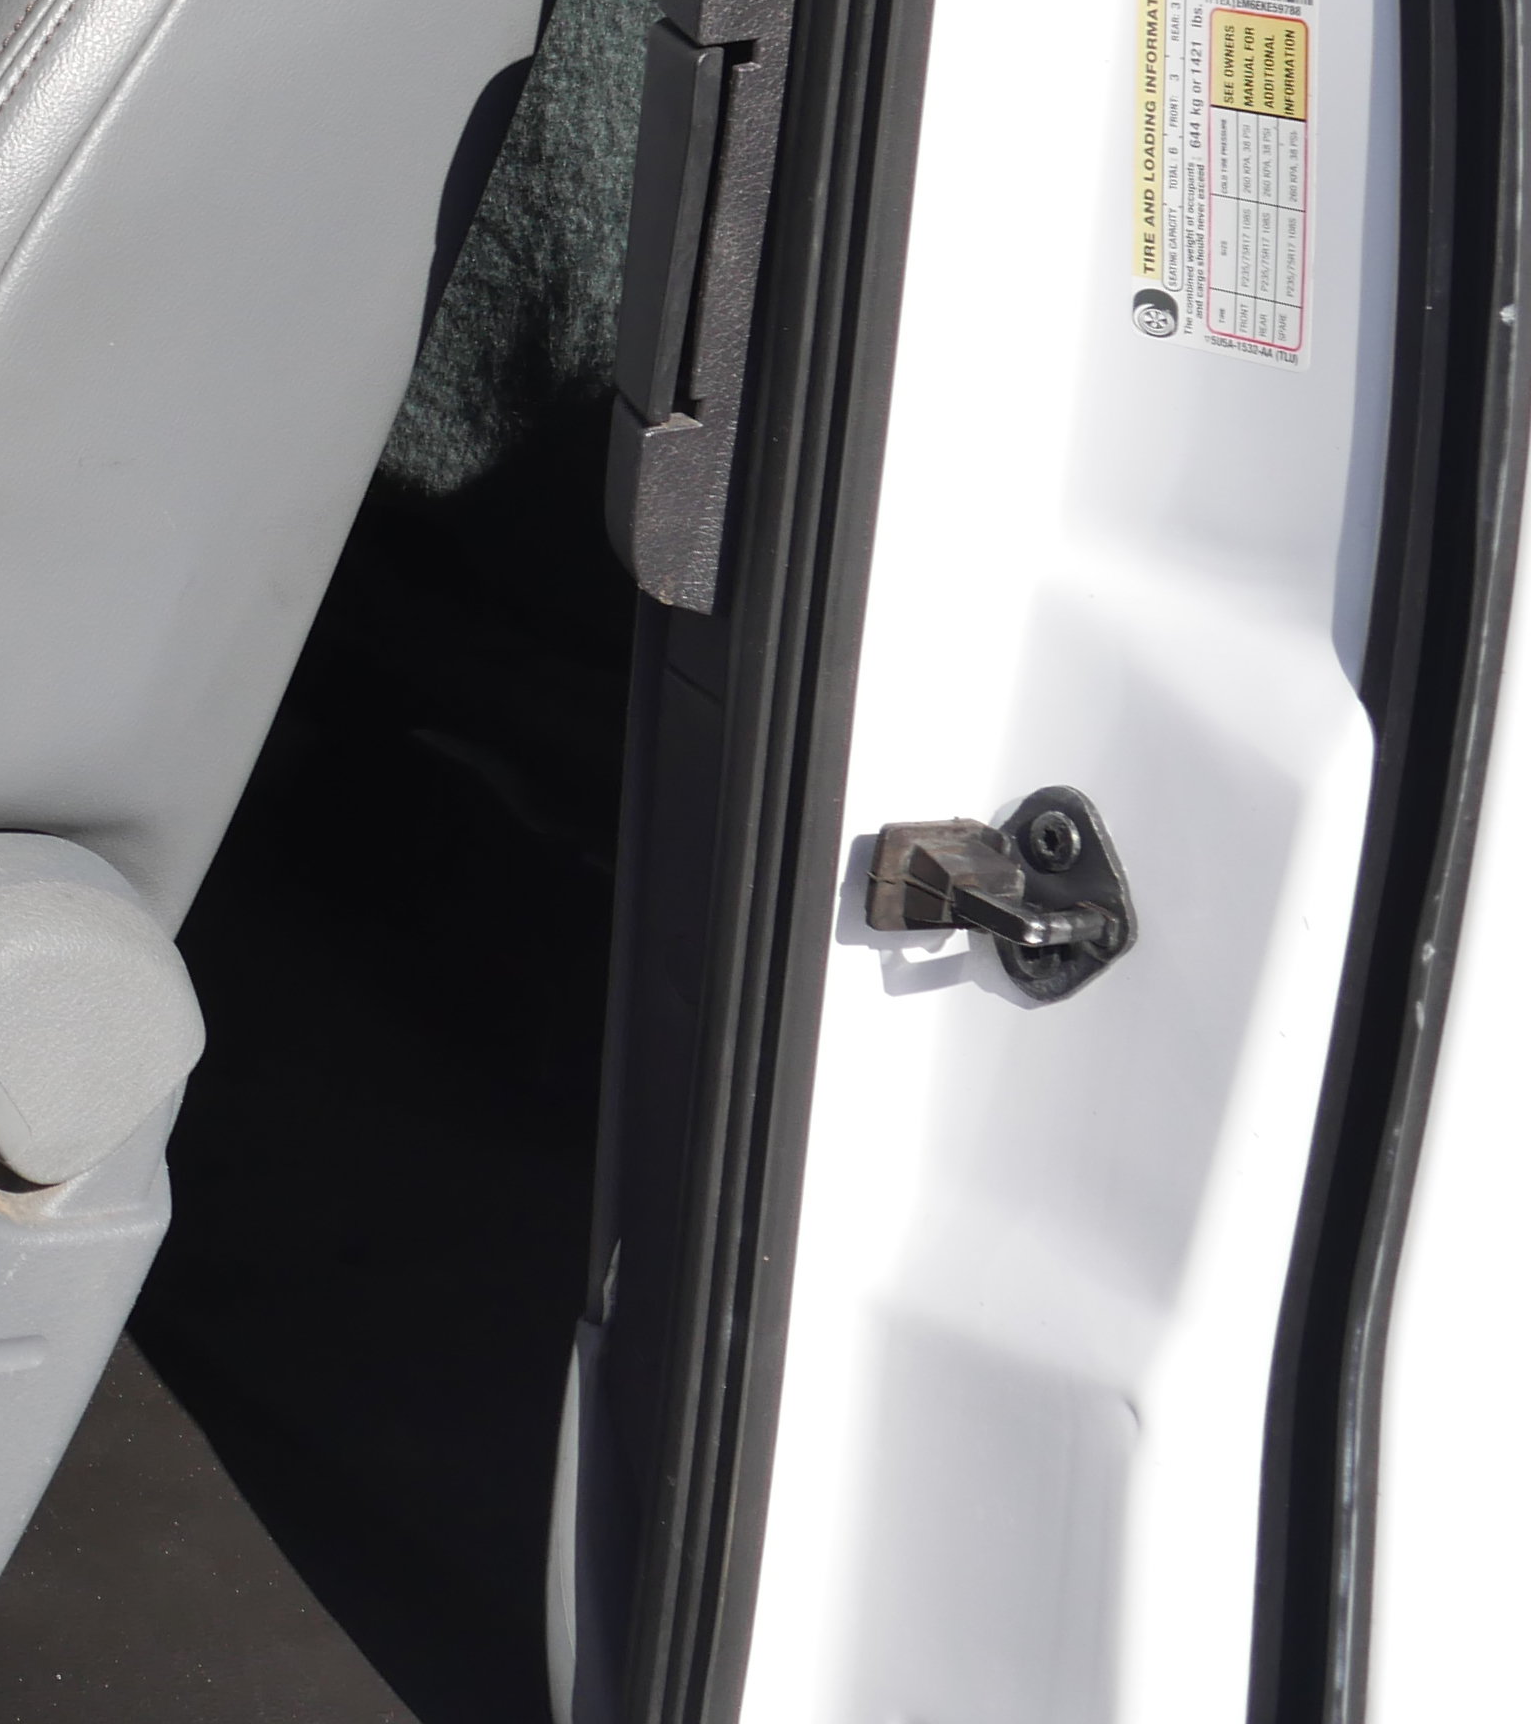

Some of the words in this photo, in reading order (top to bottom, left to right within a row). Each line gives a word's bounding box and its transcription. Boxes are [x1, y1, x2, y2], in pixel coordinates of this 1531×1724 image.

[1171, 2, 1181, 10] 3
[1224, 25, 1235, 78] OWNERS
[1244, 27, 1255, 51] FOR
[1190, 42, 1202, 74] 1421
[1264, 35, 1275, 109] ADDITIONAL
[1284, 29, 1295, 115] INFORMATION
[1169, 74, 1180, 82] 3
[1192, 78, 1201, 93] or
[1244, 55, 1254, 107] MANUAL
[1190, 98, 1204, 116] kg
[1224, 83, 1234, 104] SEE
[1144, 100, 1157, 183] LOADING
[1189, 121, 1201, 148] 644
[1243, 124, 1251, 137] PSI
[1186, 162, 1196, 213] occupants
[1196, 164, 1205, 199] exceed
[1243, 178, 1251, 194] 260
[1263, 181, 1271, 197] 260
[1289, 185, 1297, 202] 260
[1144, 190, 1156, 227] AND
[1186, 213, 1194, 226] of
[1197, 202, 1205, 231] never
[1169, 208, 1178, 250] CAPACITY
[1144, 233, 1156, 274] TIRE
[1185, 228, 1195, 263] weight
[1196, 233, 1205, 267] should
[1169, 251, 1178, 287] SEATING
[1185, 266, 1194, 313] combined
[1197, 269, 1206, 299] cargo
[1184, 314, 1193, 334] The
[1196, 301, 1204, 320] and
[1240, 304, 1249, 334] FRONT
[1259, 314, 1267, 337] REAR
[1278, 314, 1287, 342] SPARE
